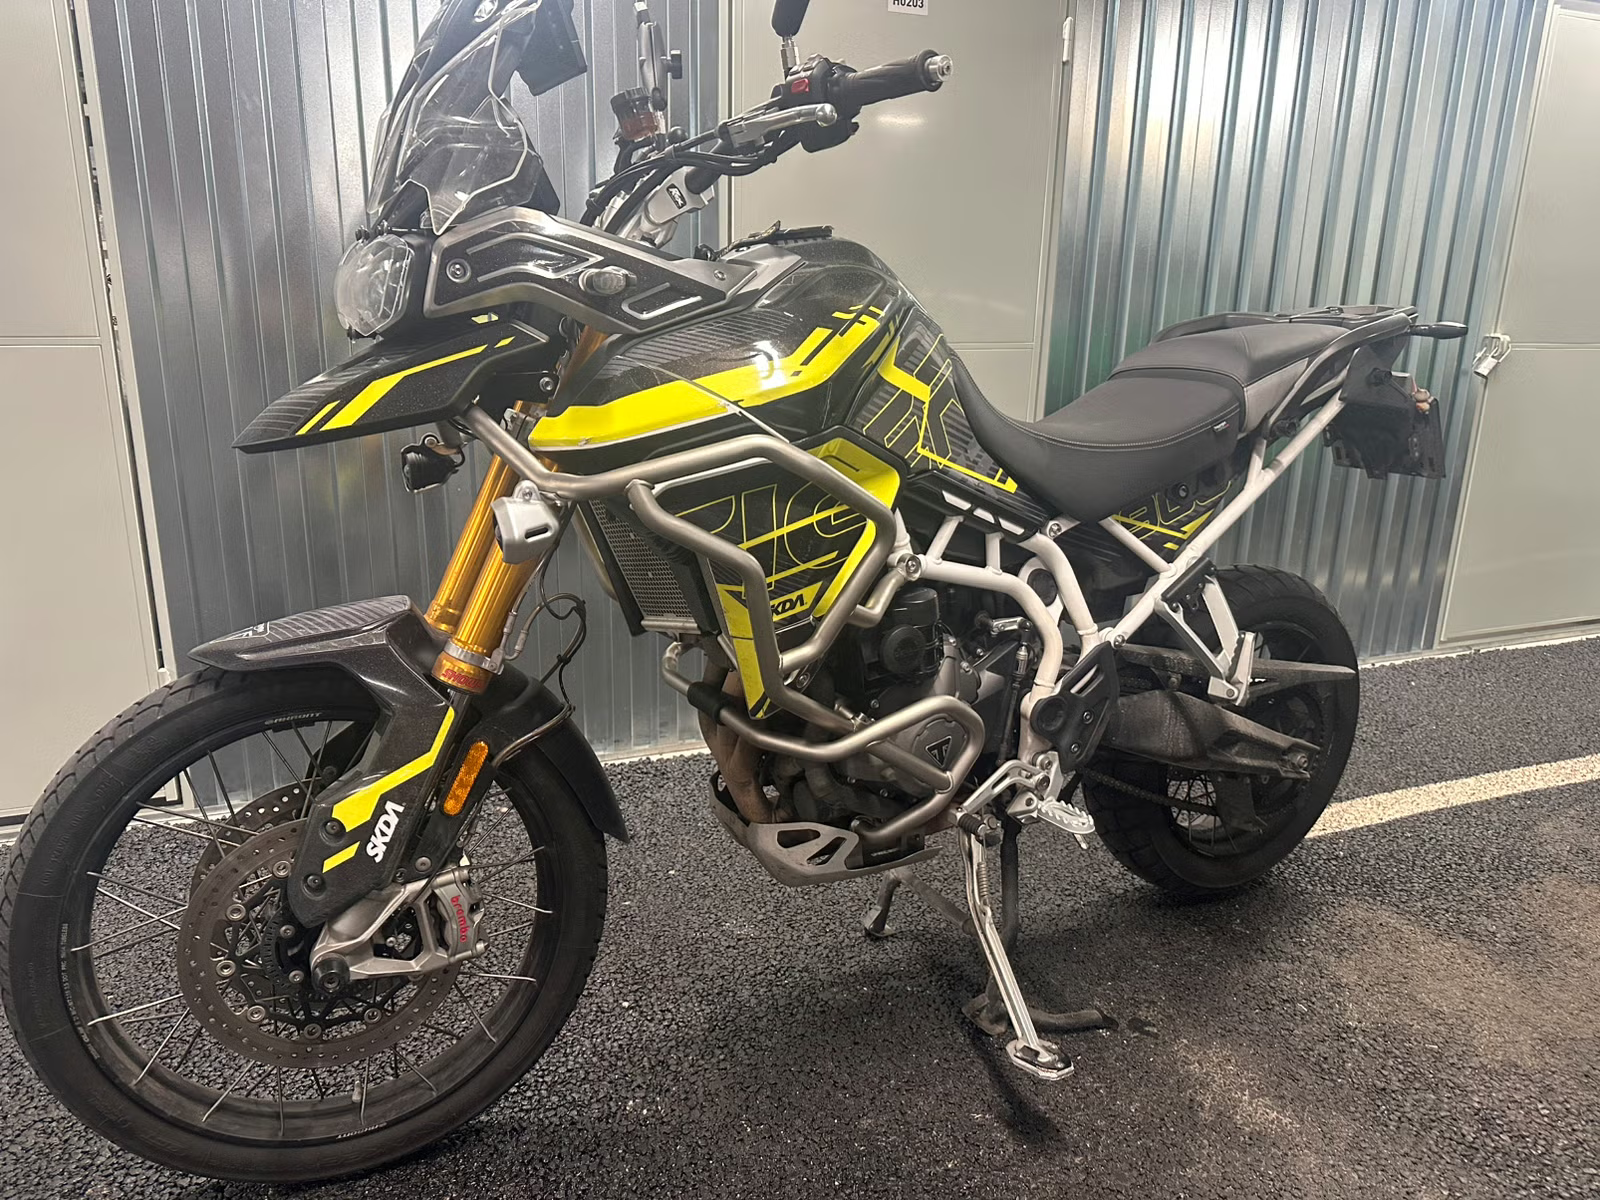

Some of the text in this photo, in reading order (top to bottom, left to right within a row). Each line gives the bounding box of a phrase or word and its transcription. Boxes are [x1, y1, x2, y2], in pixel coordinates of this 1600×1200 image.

[771, 593, 805, 615] KDA
[366, 800, 405, 863] SKDA
[450, 895, 469, 943] brembo
